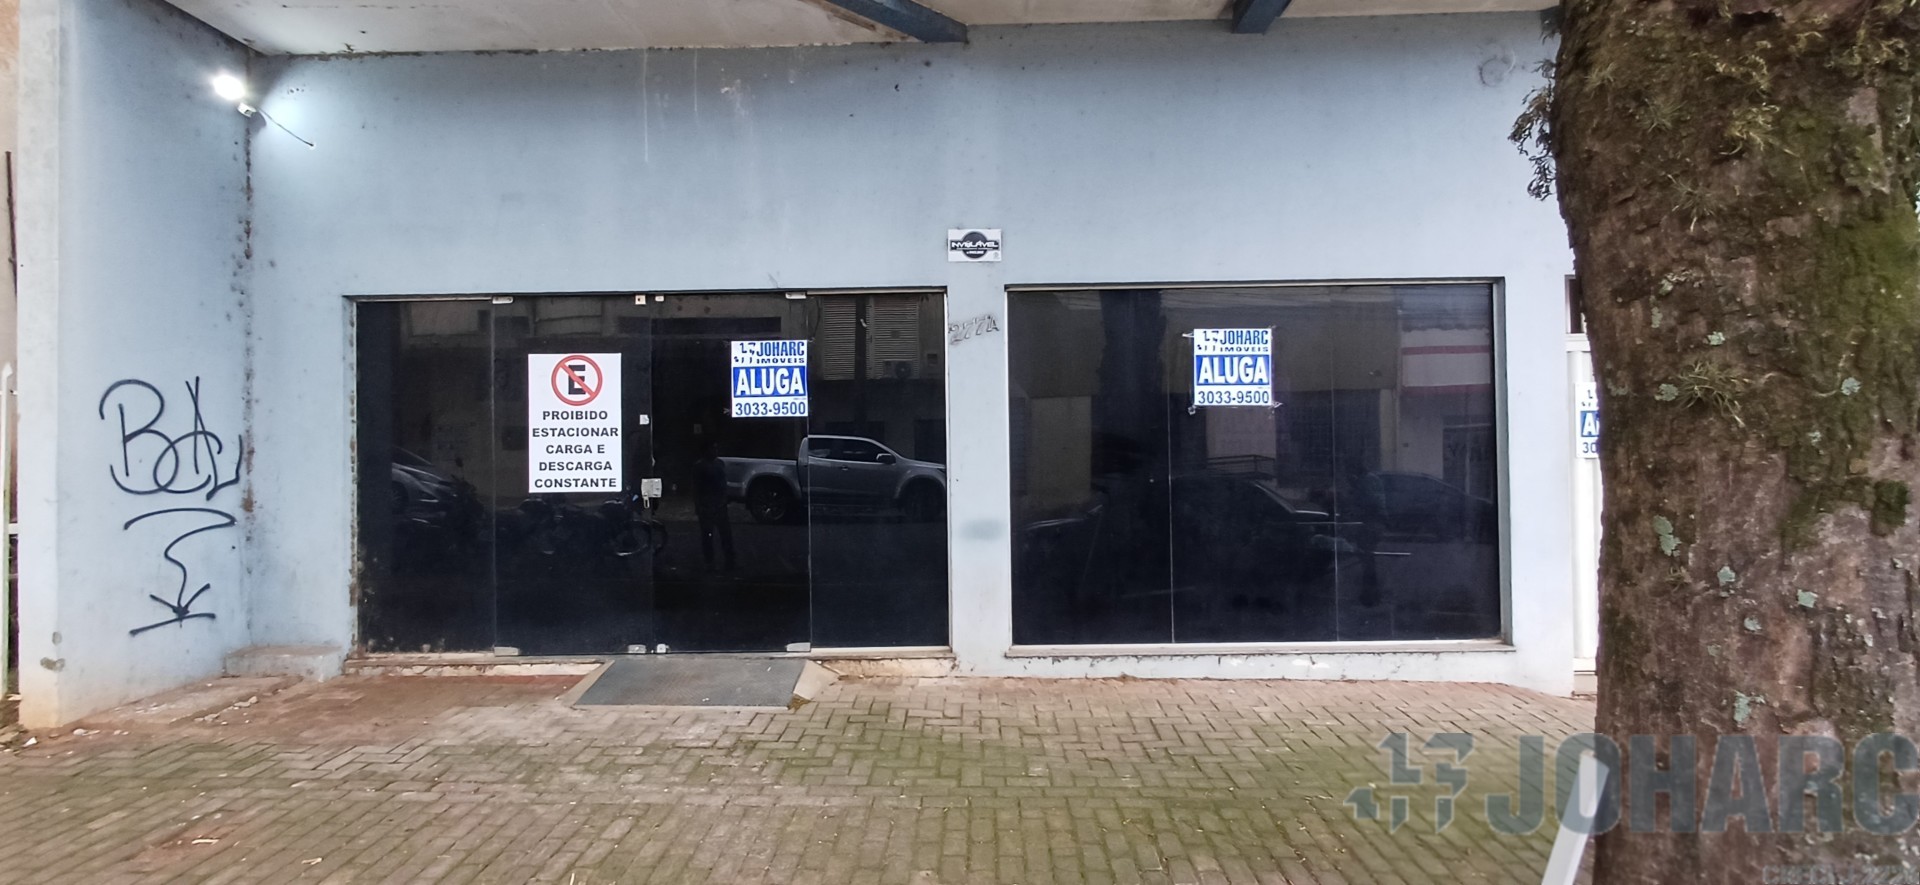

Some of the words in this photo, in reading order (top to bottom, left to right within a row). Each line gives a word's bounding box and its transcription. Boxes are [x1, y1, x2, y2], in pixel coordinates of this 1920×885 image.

[1220, 330, 1269, 345] JOHARC
[756, 341, 805, 357] JOHARC
[1198, 356, 1269, 384] ALUGA
[736, 367, 805, 396] ALUGA
[1198, 390, 1269, 404] 3033-9500
[542, 410, 608, 420] PROIBIDO
[735, 401, 806, 416] 3033-9500
[532, 427, 619, 437] ESTACIONAR
[545, 444, 593, 454] CARGA
[597, 444, 605, 454] E
[539, 461, 613, 471] DESCARGA
[534, 478, 617, 488] CONSTANTE
